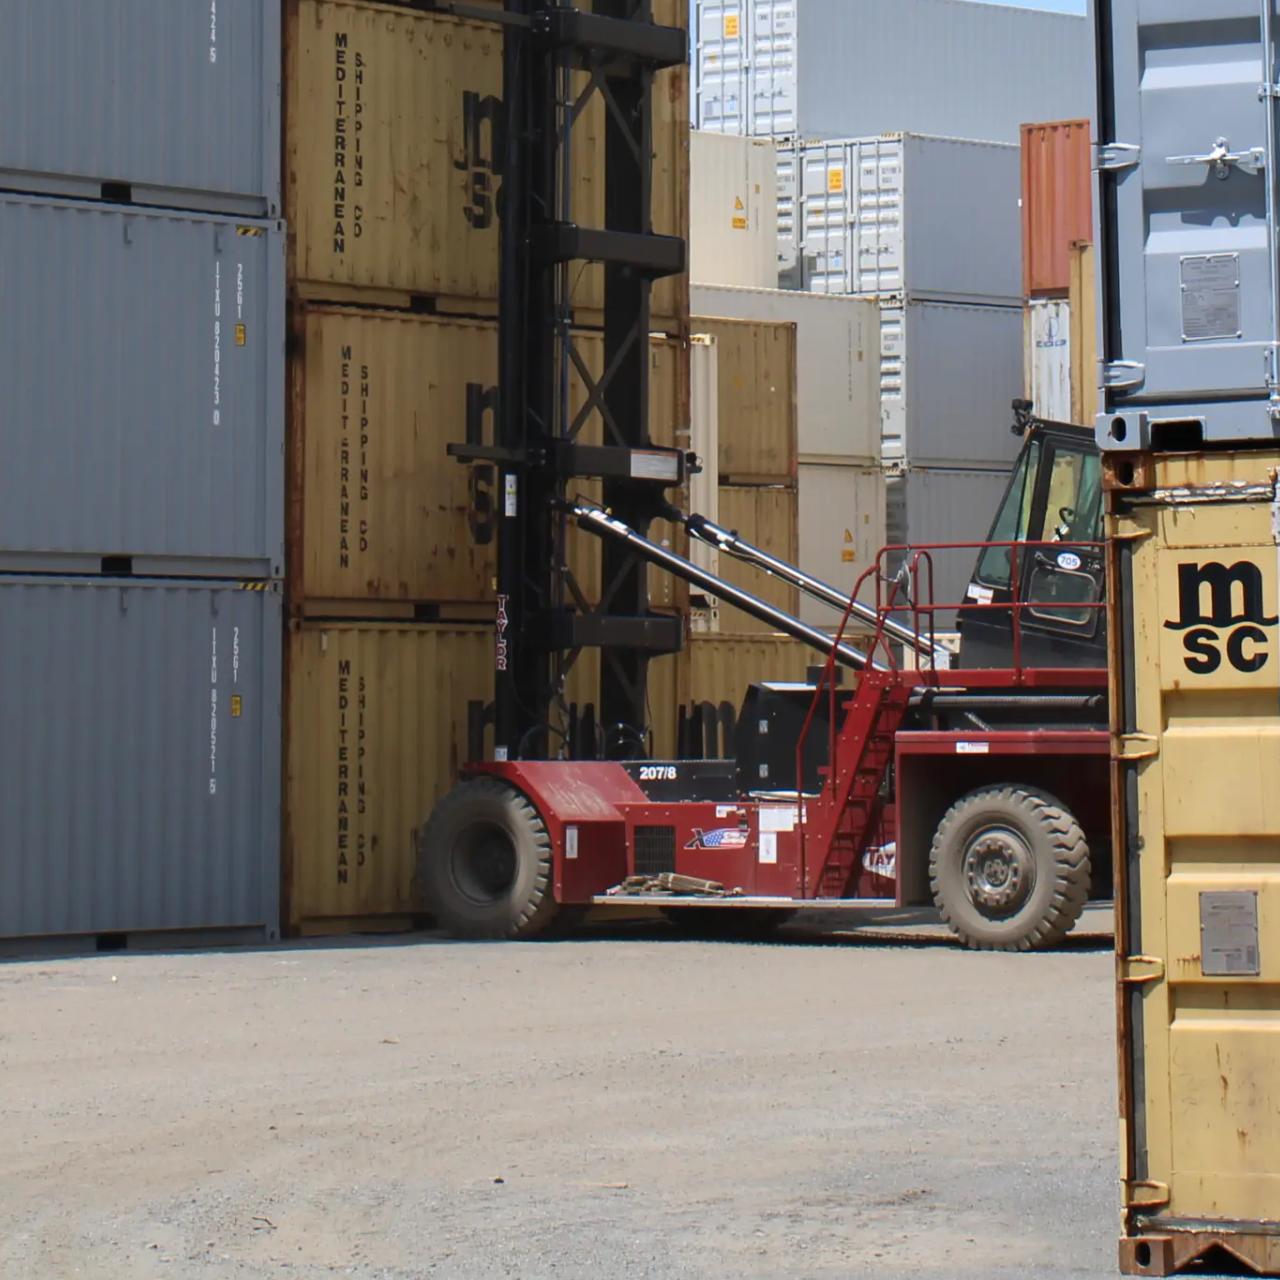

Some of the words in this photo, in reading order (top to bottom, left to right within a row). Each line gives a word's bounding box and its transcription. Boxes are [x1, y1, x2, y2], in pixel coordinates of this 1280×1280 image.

[333, 32, 348, 254] MEDITERRANEAN
[354, 51, 364, 187] SHIPPING
[359, 365, 369, 501] SHIPPING
[1060, 555, 1078, 567] 705
[495, 594, 509, 671] TAYLOR
[337, 660, 350, 884] MEDITERRANEAN
[357, 676, 366, 814] SHIPPING
[639, 766, 677, 780] 207/8
